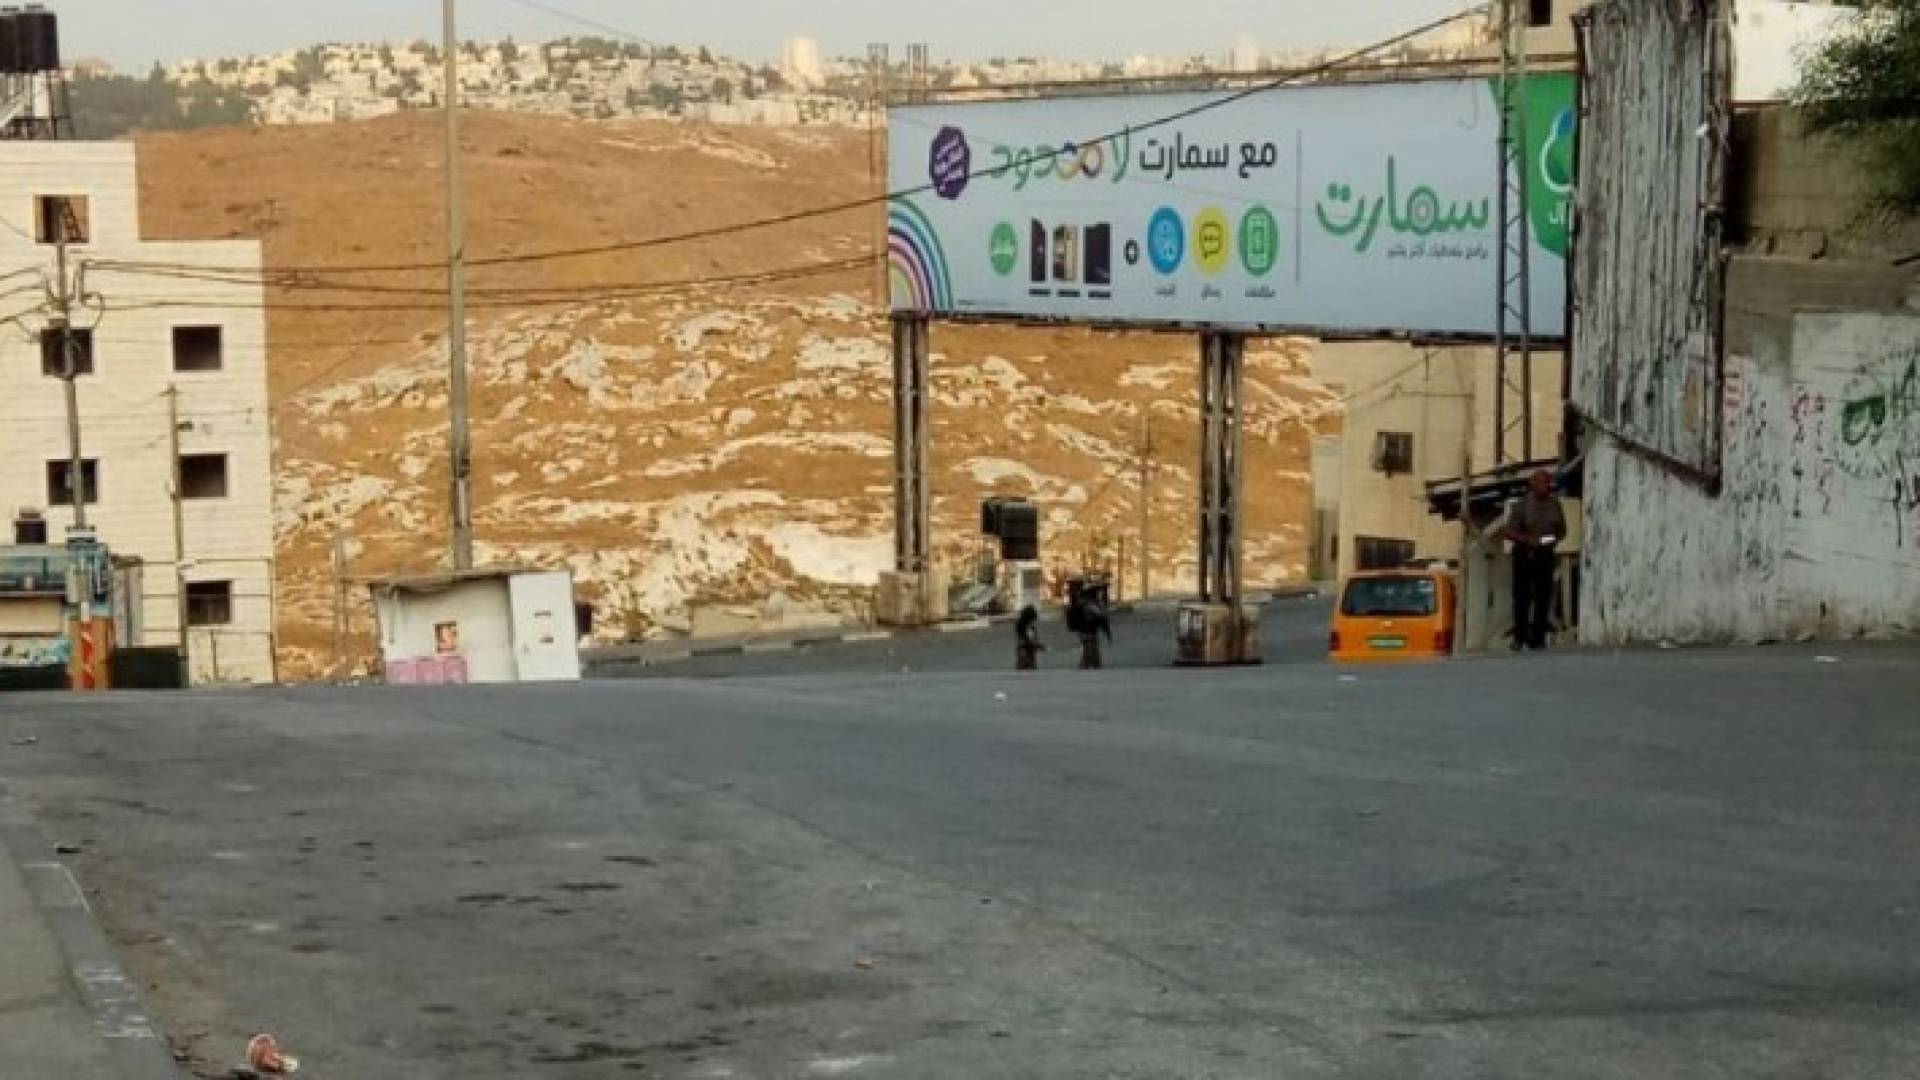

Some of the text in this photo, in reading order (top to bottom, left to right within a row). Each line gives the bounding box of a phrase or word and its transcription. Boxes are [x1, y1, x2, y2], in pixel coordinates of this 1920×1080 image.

[1111, 124, 1130, 184] لا
[1139, 131, 1229, 181] سمارت
[1239, 142, 1277, 178] مع
[1314, 153, 1489, 251] سمارت
